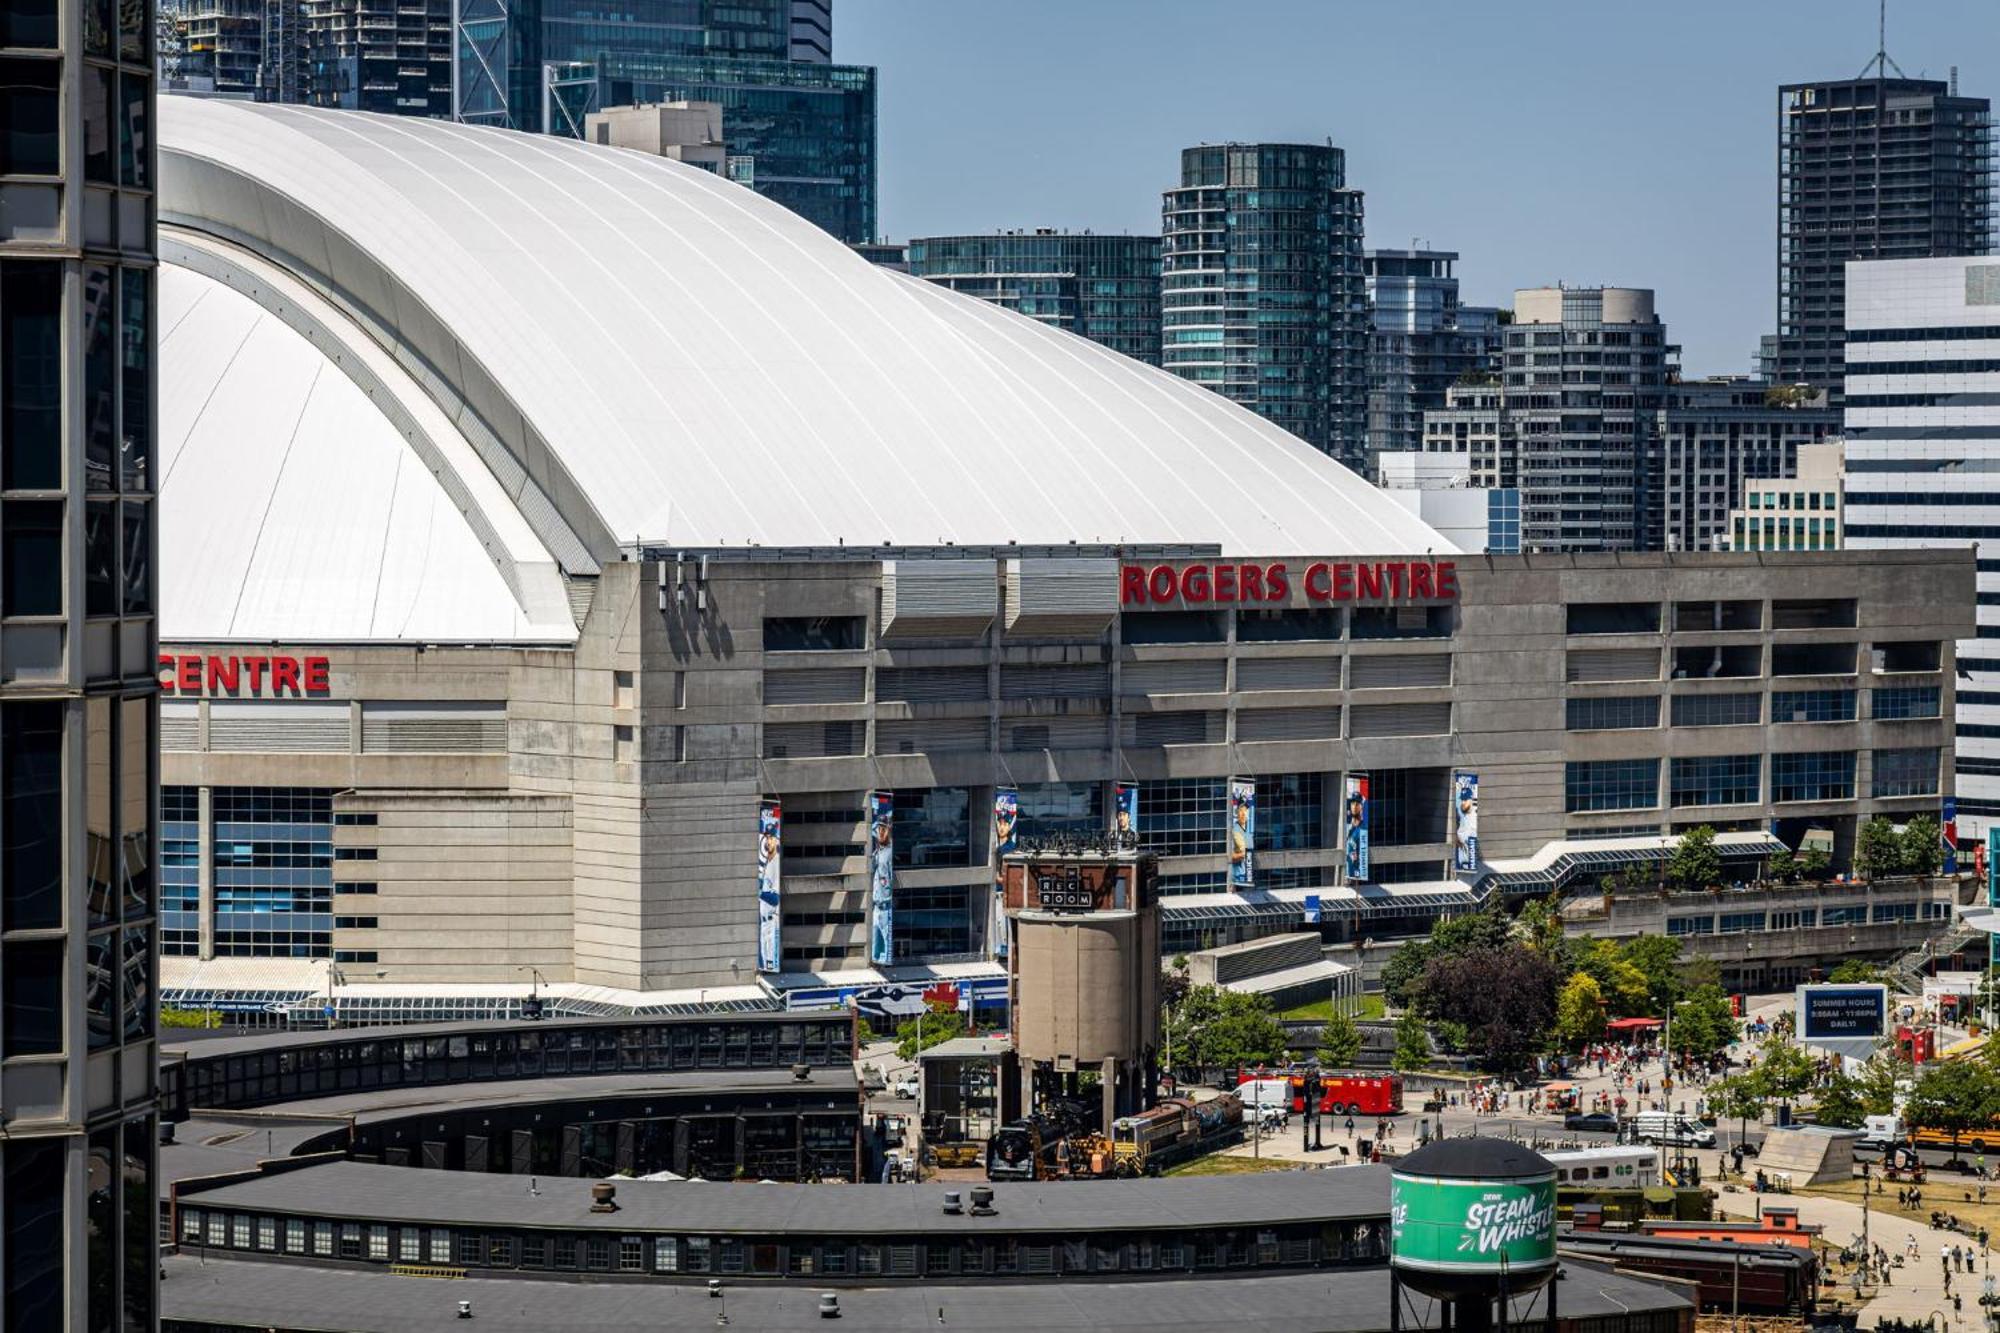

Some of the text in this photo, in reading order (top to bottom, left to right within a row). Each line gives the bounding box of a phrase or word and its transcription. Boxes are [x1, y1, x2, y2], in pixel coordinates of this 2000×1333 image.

[1120, 560, 1456, 605] ROGERS CENTRE
[1043, 882, 1076, 890] REC
[1043, 895, 1089, 905] ROOM
[1812, 998, 1876, 1007] SUMMER HOURS
[1465, 1193, 1536, 1230] STEAM
